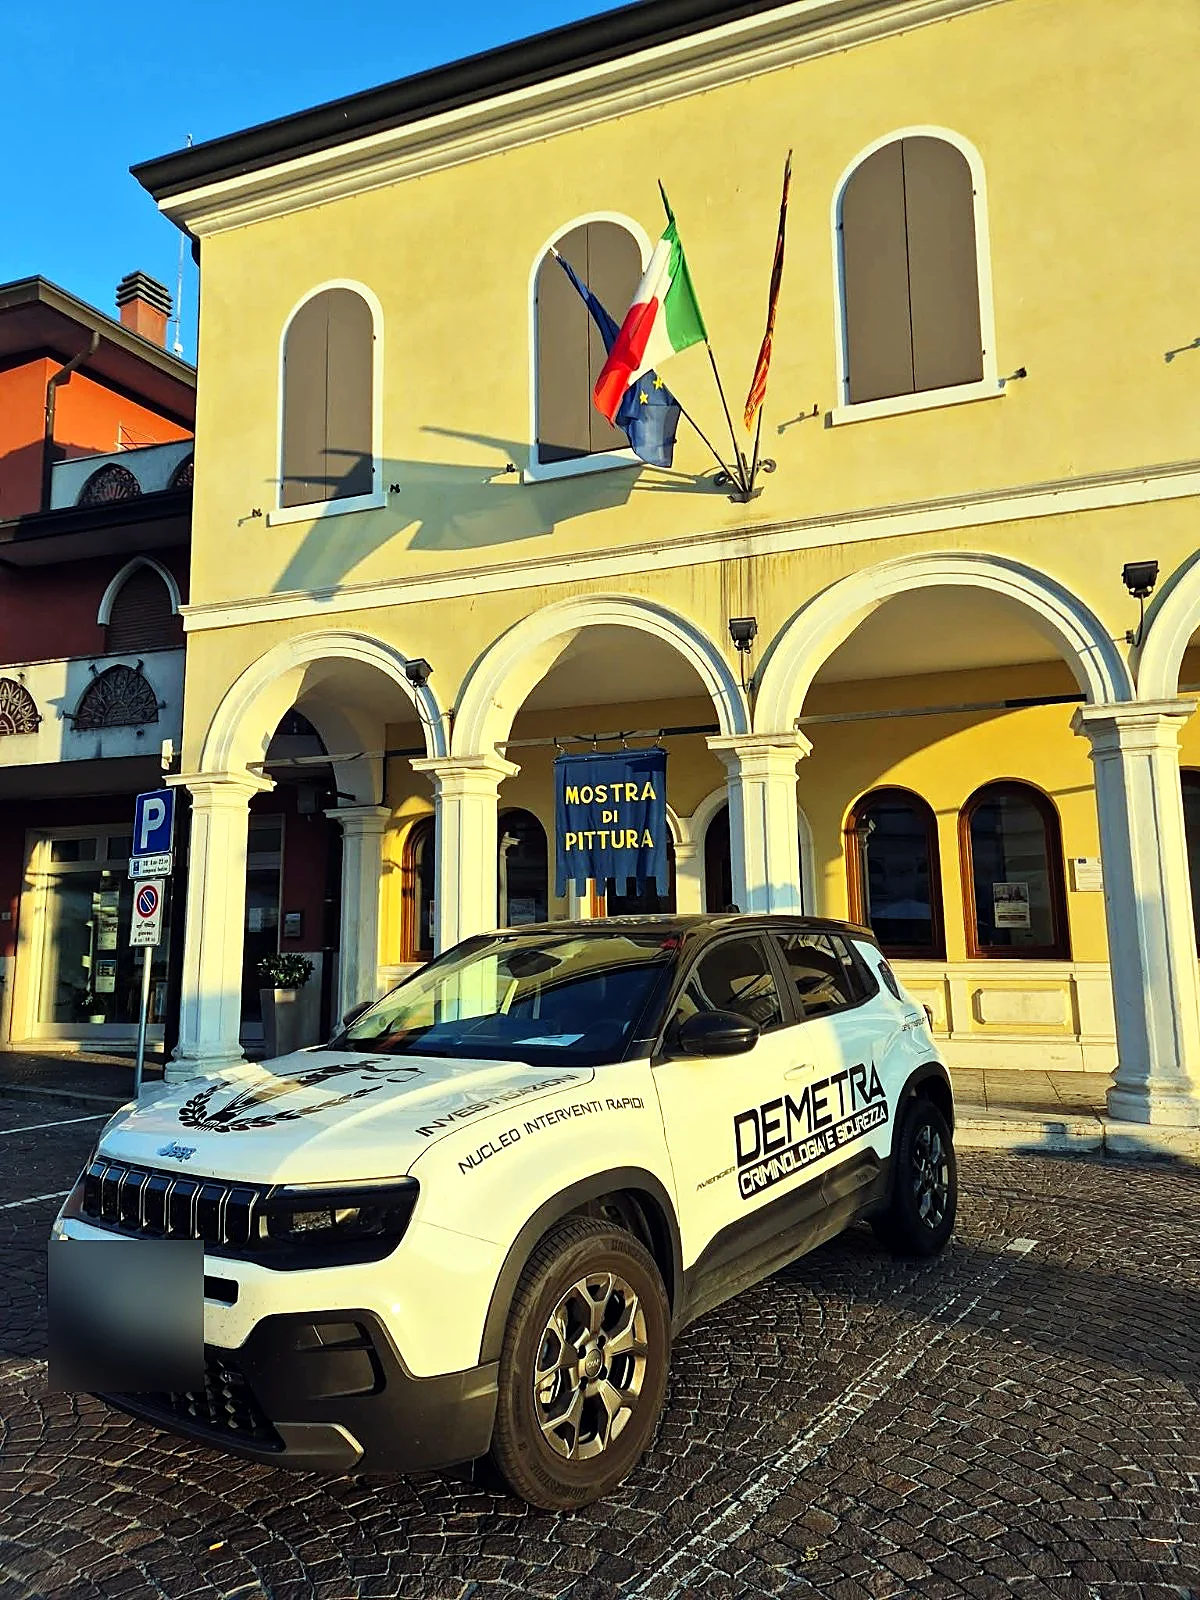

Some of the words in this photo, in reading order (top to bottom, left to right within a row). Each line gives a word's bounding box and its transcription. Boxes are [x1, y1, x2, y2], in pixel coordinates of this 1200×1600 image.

[565, 781, 657, 805] MOSTRA
[602, 810, 618, 824] DI
[140, 797, 166, 849] P
[565, 829, 654, 851] PITTURA
[415, 1074, 580, 1138] INVESTIGAZIONI
[733, 1060, 886, 1168] DEMETRA
[825, 1130, 837, 1151] E
[835, 1107, 887, 1143] SICUREZZA
[457, 1128, 521, 1175] NUCLEO
[523, 1100, 603, 1135] INTERVENTI
[606, 1097, 644, 1111] RAPIDI
